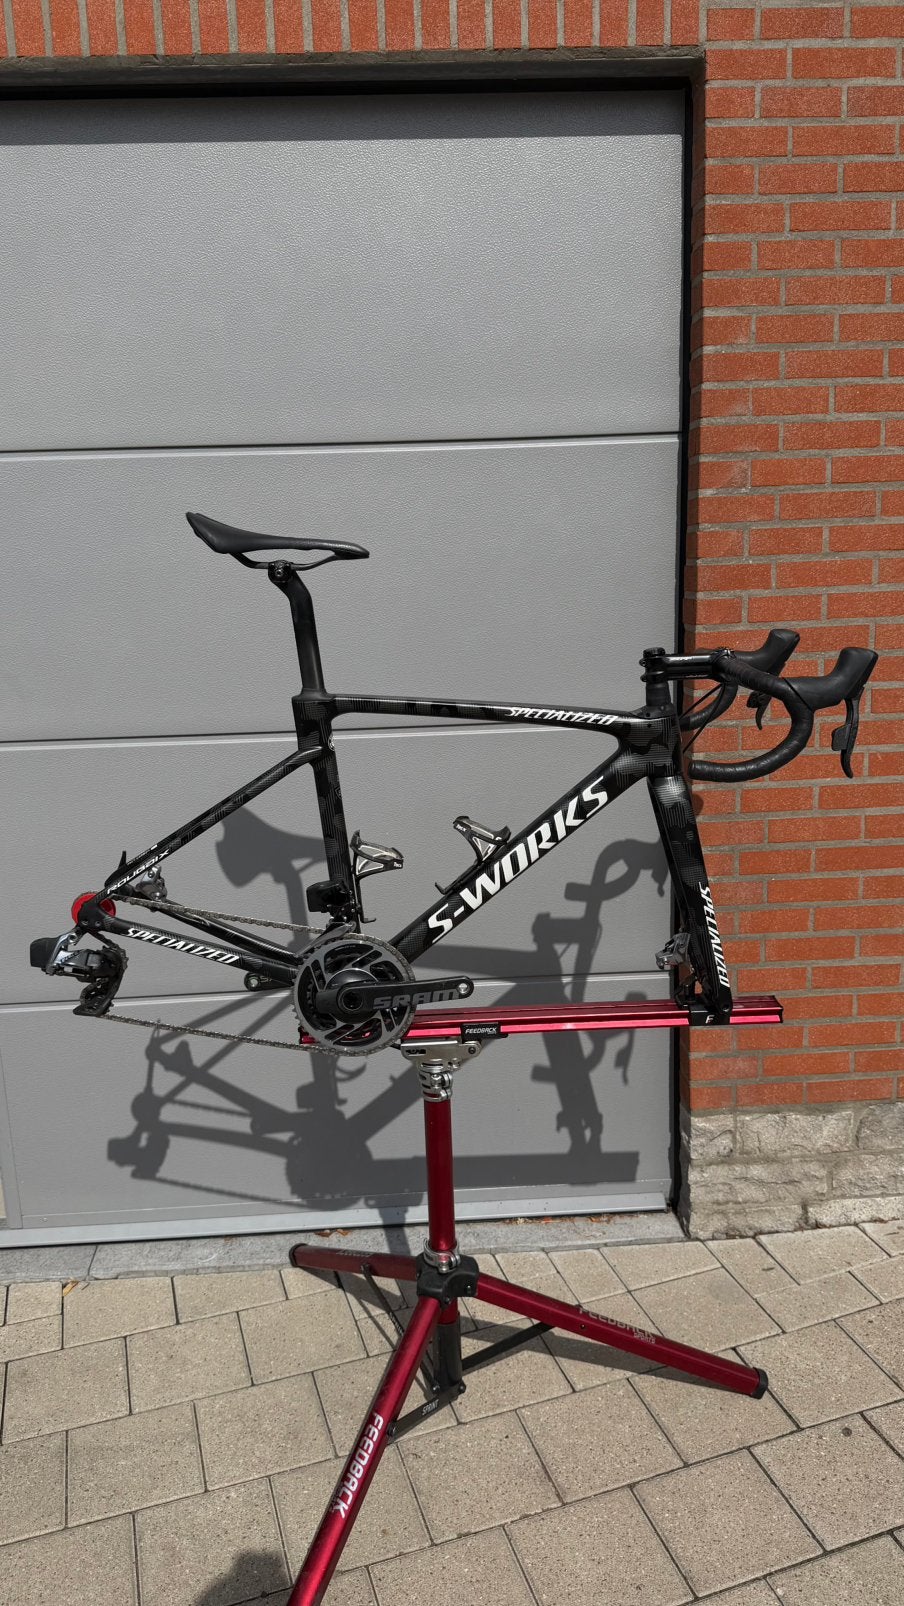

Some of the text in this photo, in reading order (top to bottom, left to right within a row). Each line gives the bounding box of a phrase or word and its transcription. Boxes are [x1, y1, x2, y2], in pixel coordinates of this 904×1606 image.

[504, 706, 619, 726] SPECIALIZED
[106, 849, 170, 895] ROUBAIX
[428, 775, 608, 944] S-WORKS
[126, 927, 240, 965] SPECIALIZED
[698, 881, 731, 988] SPECIALIZED
[373, 989, 460, 1010] SRAM
[465, 1027, 497, 1035] FEEDBACK
[422, 1399, 440, 1416] SPRINT
[333, 1411, 384, 1519] FEEDBACK
